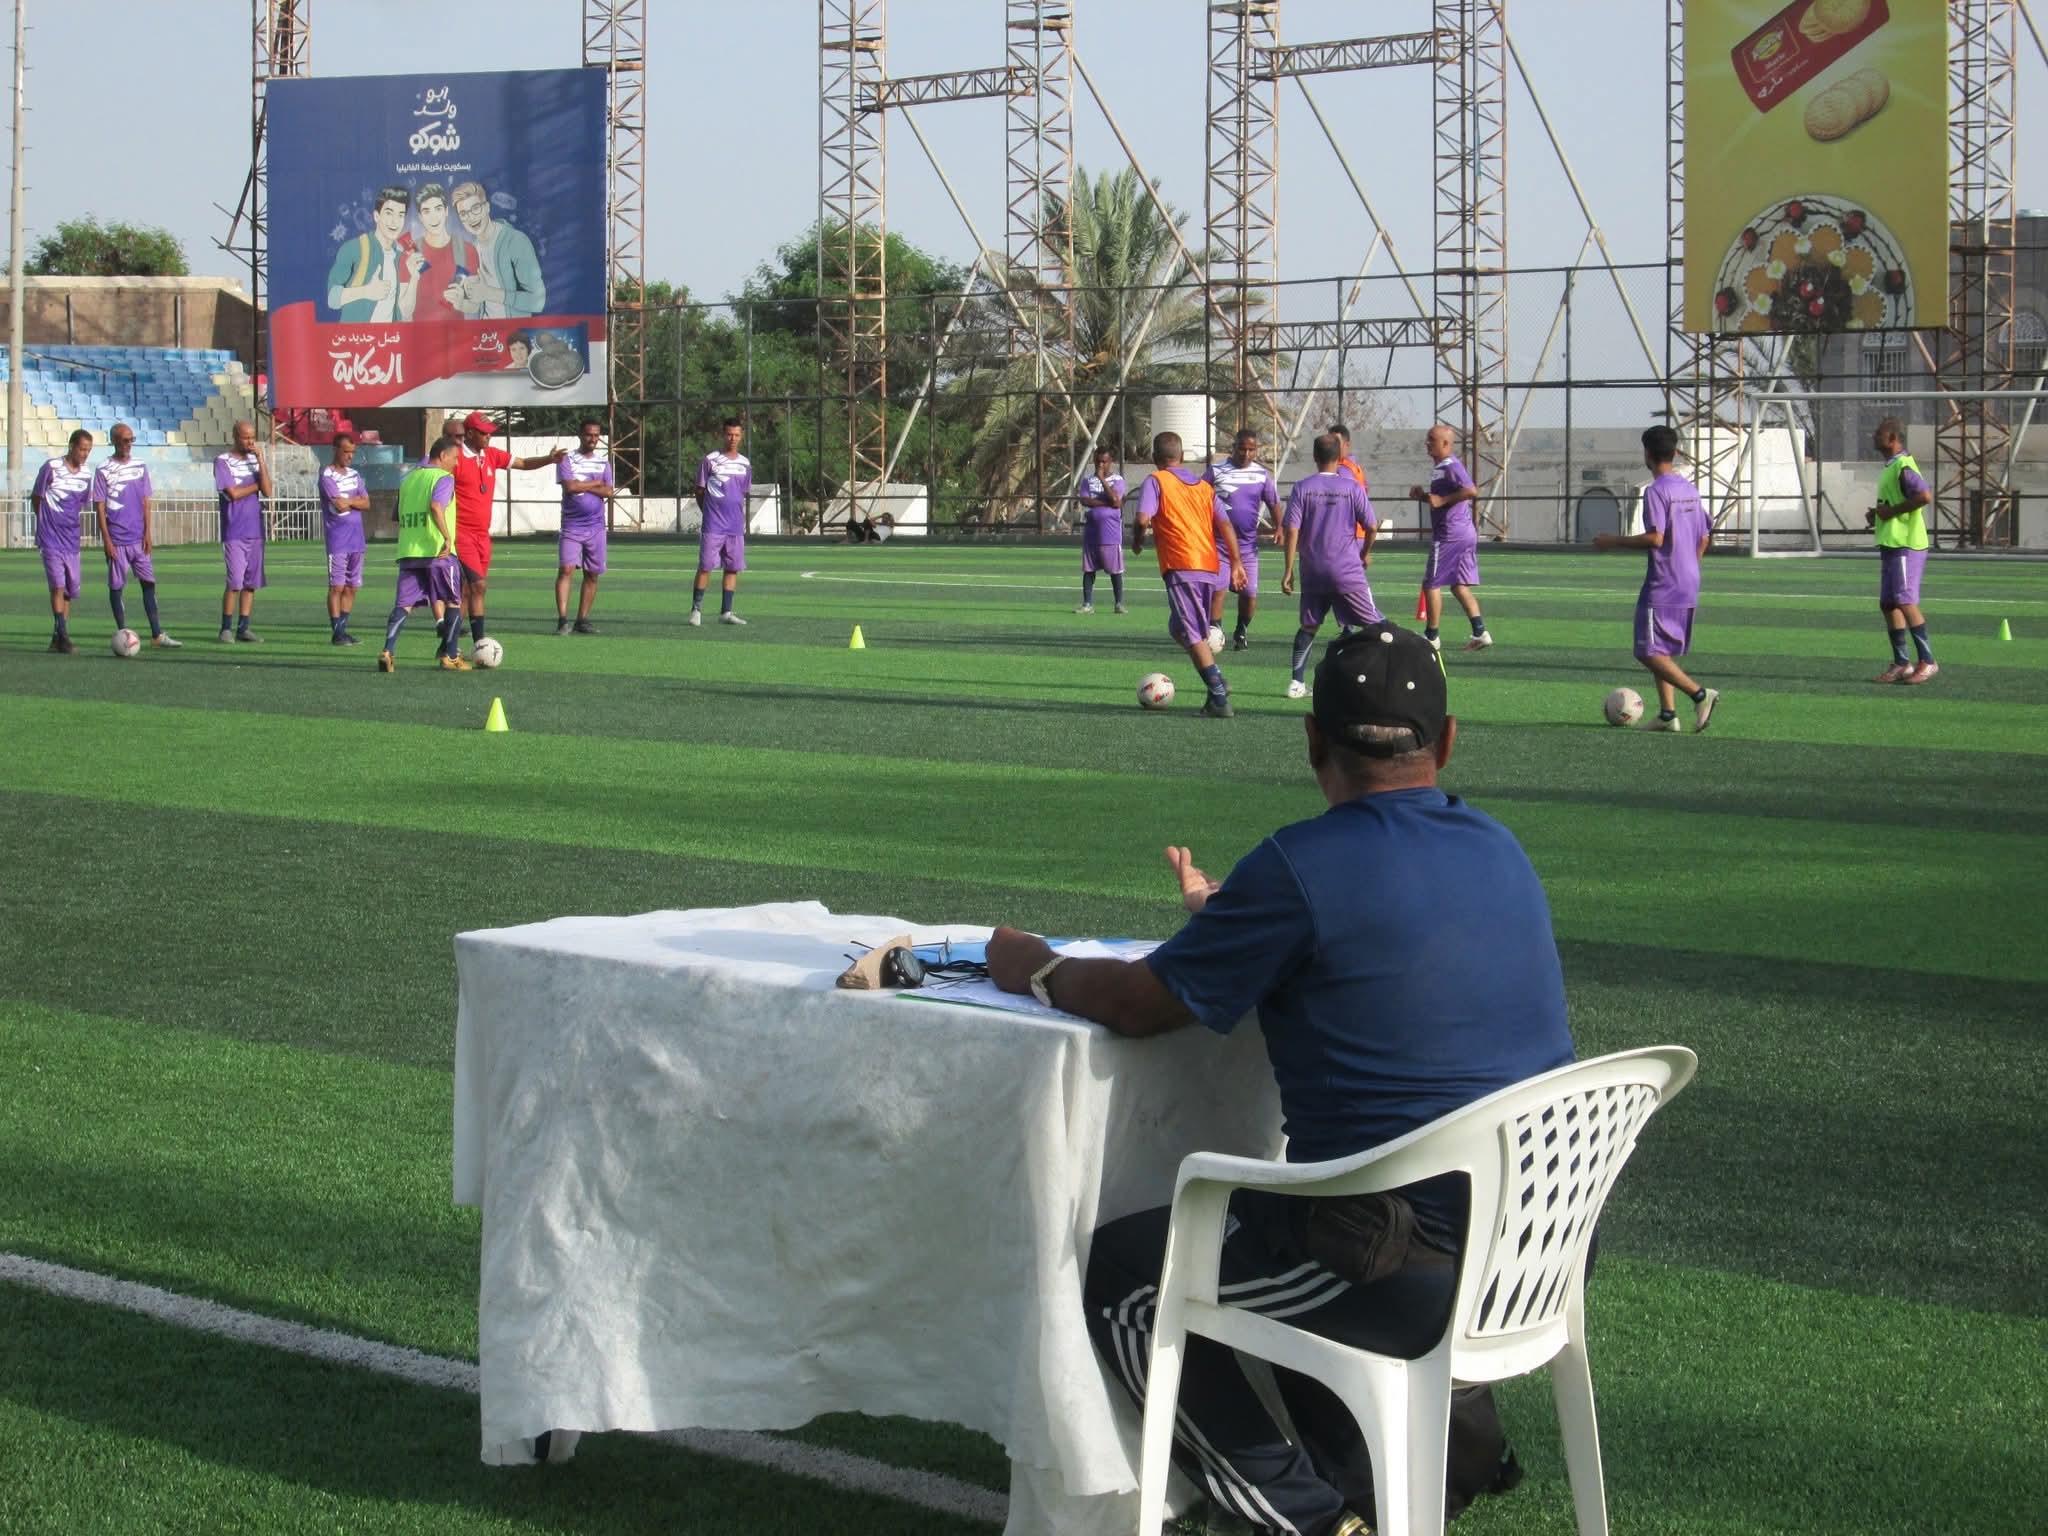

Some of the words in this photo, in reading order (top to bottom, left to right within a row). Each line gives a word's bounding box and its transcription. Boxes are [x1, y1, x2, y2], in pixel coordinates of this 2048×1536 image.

[413, 99, 457, 119] ولد
[409, 120, 461, 156] شوكو
[443, 161, 471, 172] بسكويت
[331, 334, 347, 347] من
[348, 333, 376, 347] جديد
[377, 331, 401, 348] فصل
[328, 346, 403, 391] الحكاية
